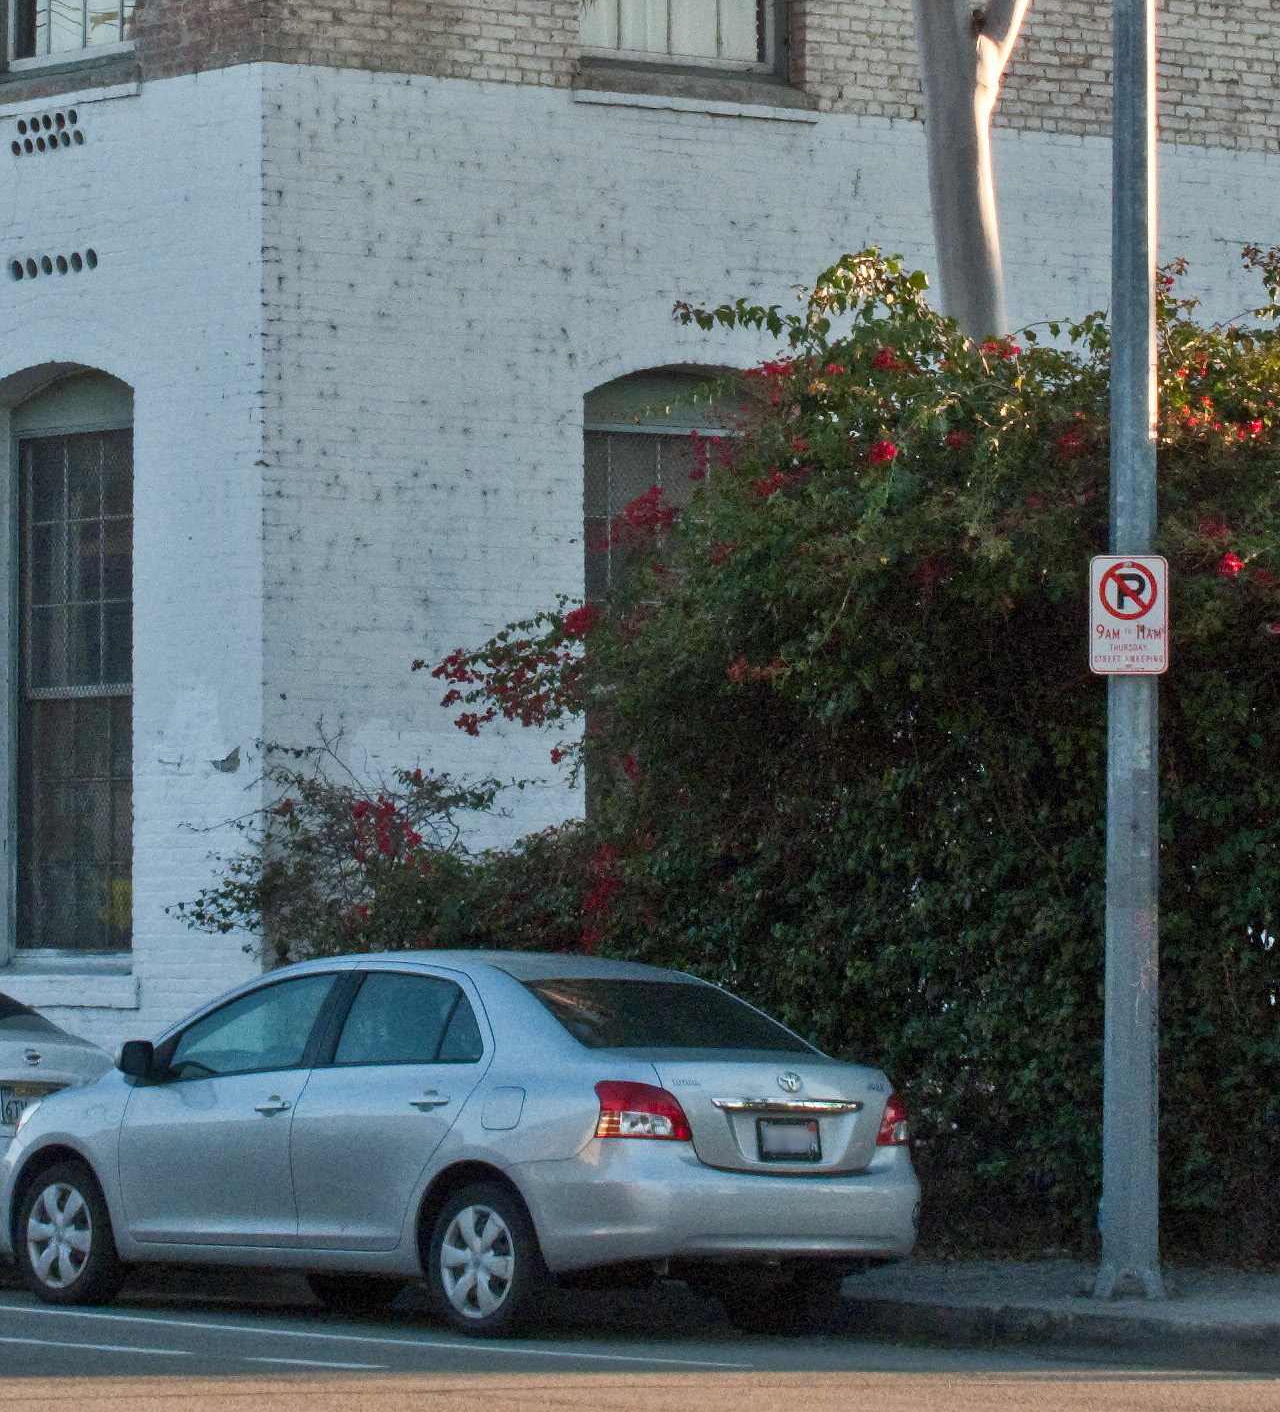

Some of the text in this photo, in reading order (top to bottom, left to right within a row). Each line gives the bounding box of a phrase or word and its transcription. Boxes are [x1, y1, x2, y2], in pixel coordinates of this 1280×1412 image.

[1096, 623, 1120, 639] 9AM
[1110, 643, 1147, 652] THURSDAY
[1094, 654, 1163, 663] STREET SWEEPING
